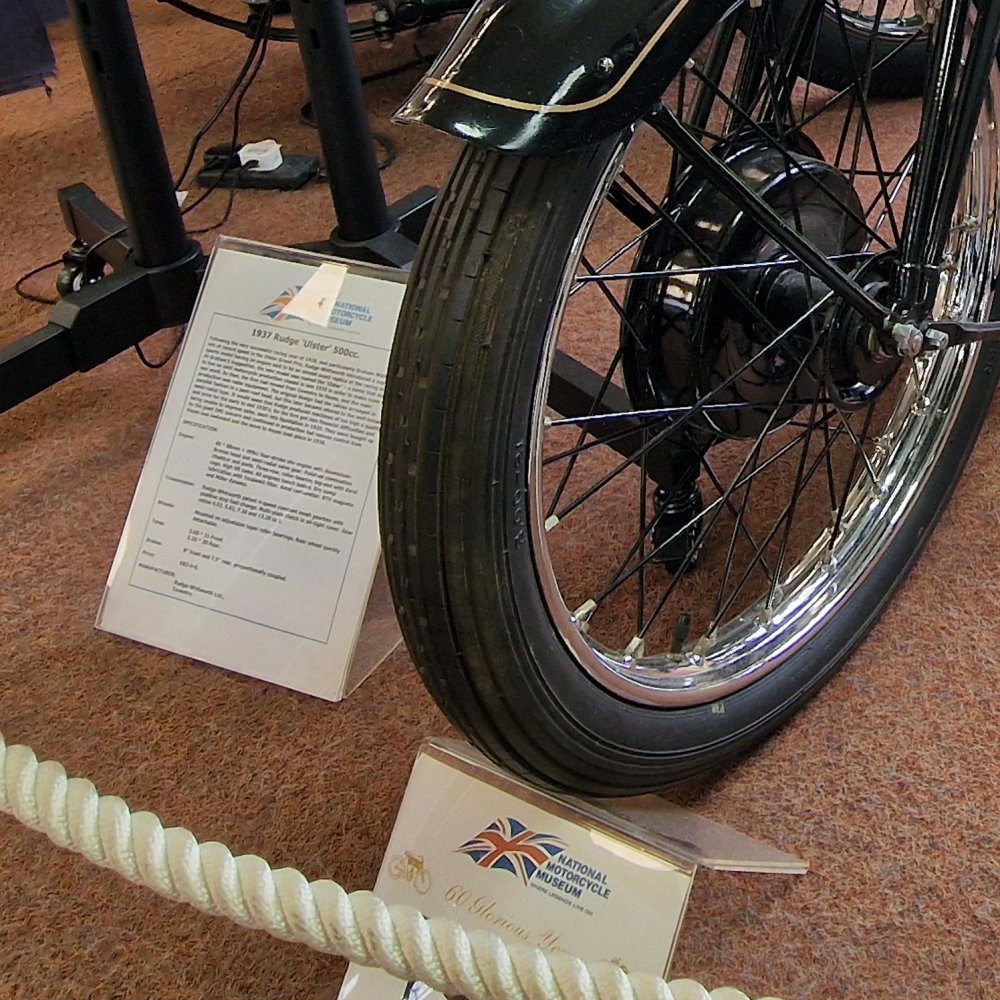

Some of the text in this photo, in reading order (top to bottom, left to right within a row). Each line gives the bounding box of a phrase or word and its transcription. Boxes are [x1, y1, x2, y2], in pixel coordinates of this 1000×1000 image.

[331, 316, 353, 326] SEUM
[332, 309, 373, 322] OTORCYCLE
[334, 301, 370, 314] NATIONAL
[252, 328, 272, 340] 1937
[274, 334, 299, 346] Rudge
[334, 345, 360, 359] 500cc.
[536, 870, 582, 899] MUSEUM
[546, 861, 611, 899] MOTORCYCLE
[558, 854, 608, 885] NATIONAL
[444, 885, 472, 905] 60
[469, 895, 530, 941] Glorious
